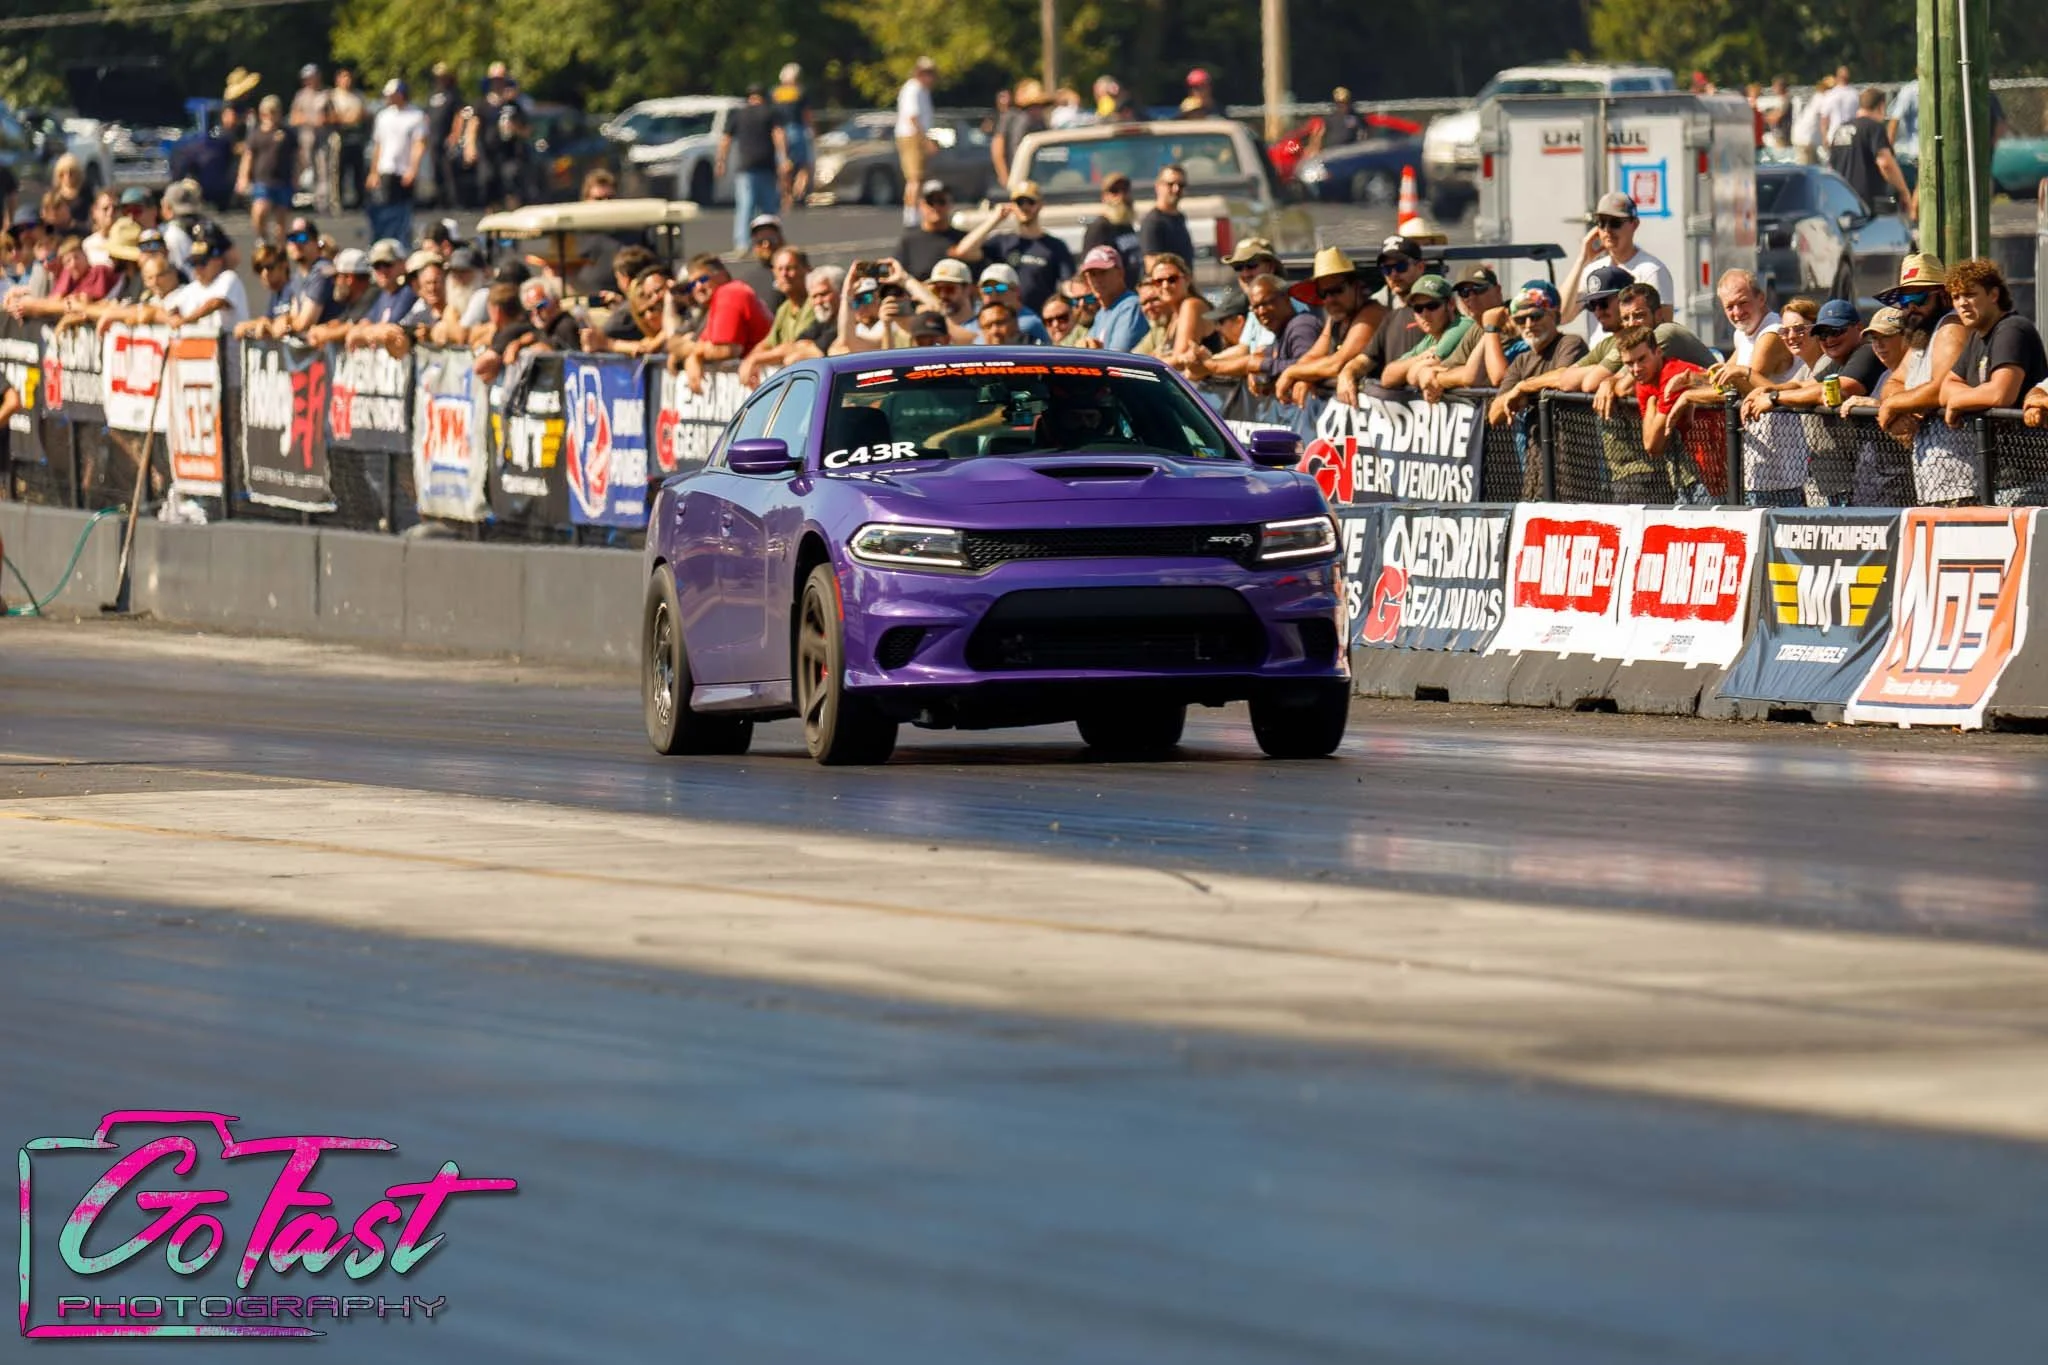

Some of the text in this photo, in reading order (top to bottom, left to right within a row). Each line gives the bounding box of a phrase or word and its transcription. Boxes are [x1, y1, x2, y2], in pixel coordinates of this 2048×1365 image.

[905, 368, 962, 380] SICK
[963, 366, 1050, 377] SUMMER
[1052, 366, 1102, 376] 2025
[823, 441, 919, 469] C43R
[1352, 453, 1474, 504] GEAR VENDORS
[1796, 558, 1859, 634] M/T
[1888, 520, 2019, 674] NOS
